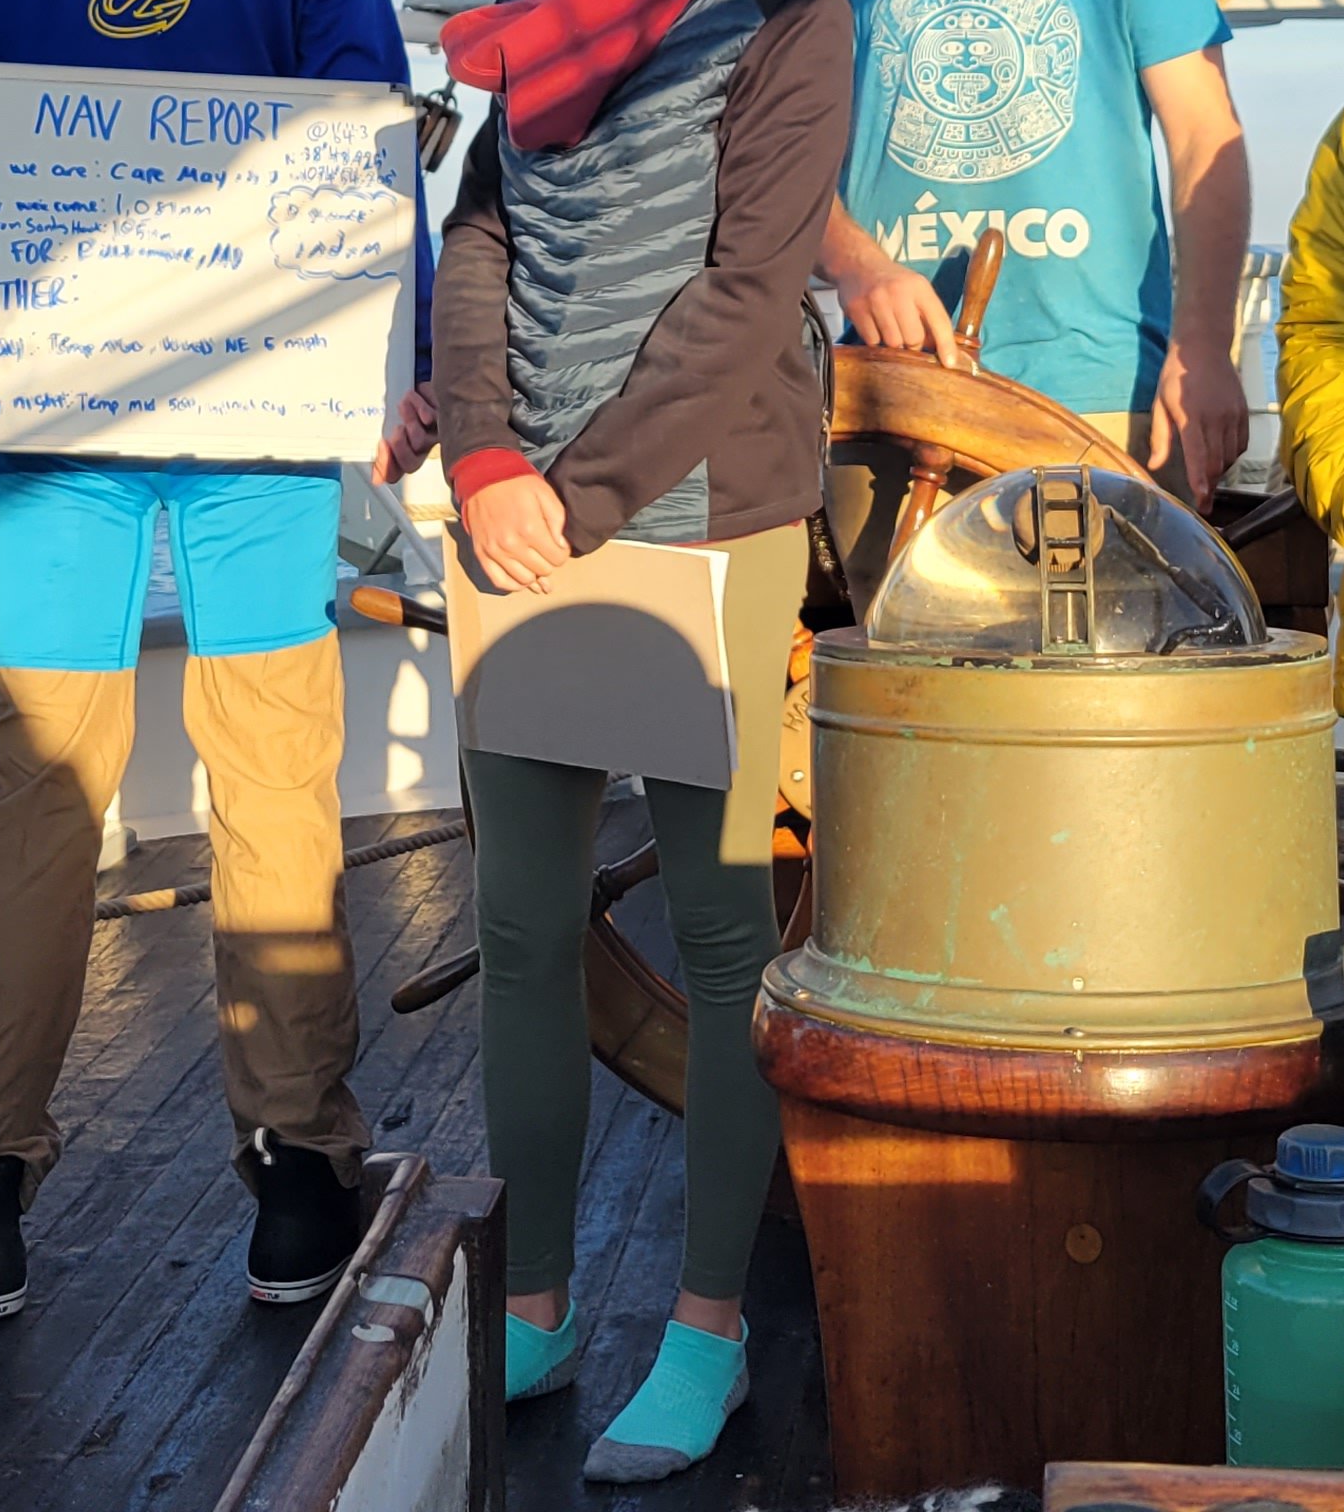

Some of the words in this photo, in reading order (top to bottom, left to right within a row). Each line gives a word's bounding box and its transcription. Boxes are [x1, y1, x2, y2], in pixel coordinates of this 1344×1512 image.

[35, 92, 122, 141] NAV
[149, 95, 294, 146] REPORT
[9, 162, 38, 176] we
[877, 190, 1090, 263] MÉXICO
[225, 338, 251, 354] NE
[77, 392, 119, 415] Temp
